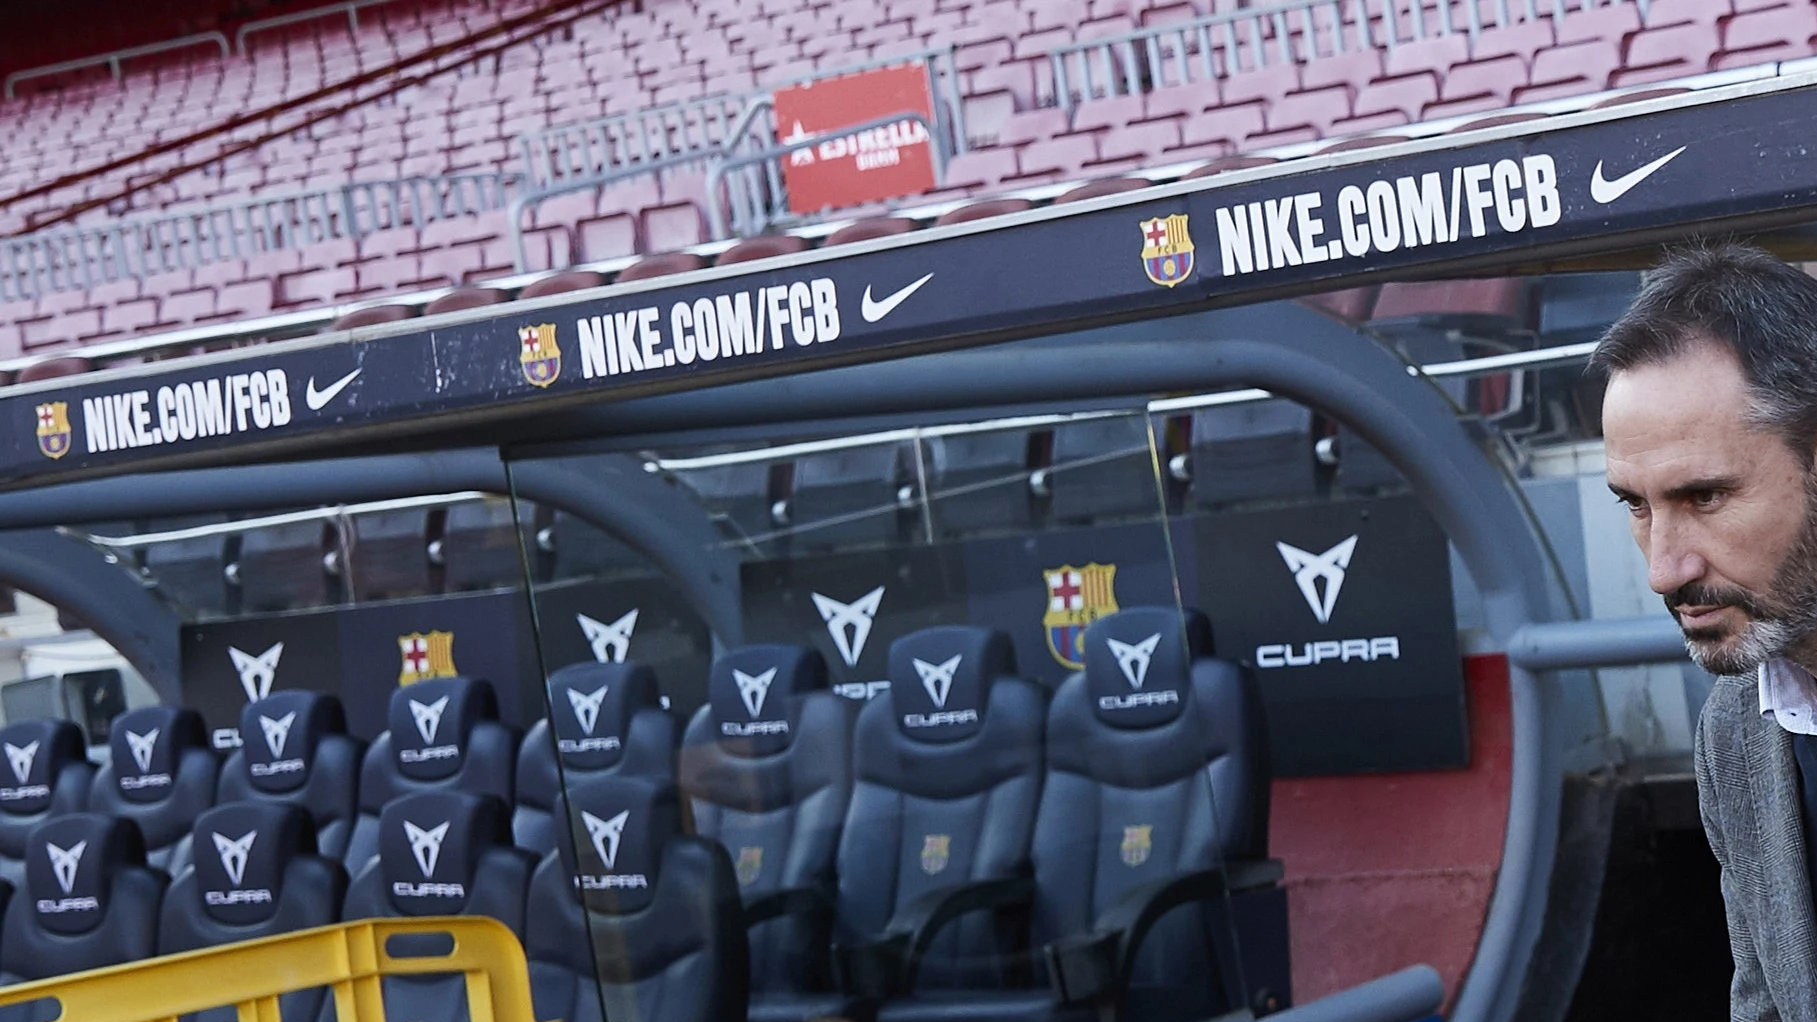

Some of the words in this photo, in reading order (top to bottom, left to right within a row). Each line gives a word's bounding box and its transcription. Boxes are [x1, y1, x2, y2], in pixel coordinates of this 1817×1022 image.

[1216, 154, 1561, 276] NIKE.COM/FCB
[577, 278, 840, 379] NIKE.COM/FCB
[83, 369, 290, 453] NIKE.COM/FCB
[1256, 636, 1400, 669] CUPRA
[1099, 689, 1179, 710] CUPRA
[904, 708, 978, 728] CUPRA
[393, 881, 465, 898] CUPRA
[573, 873, 648, 890] CUPRA
[205, 889, 272, 905] CUPRA
